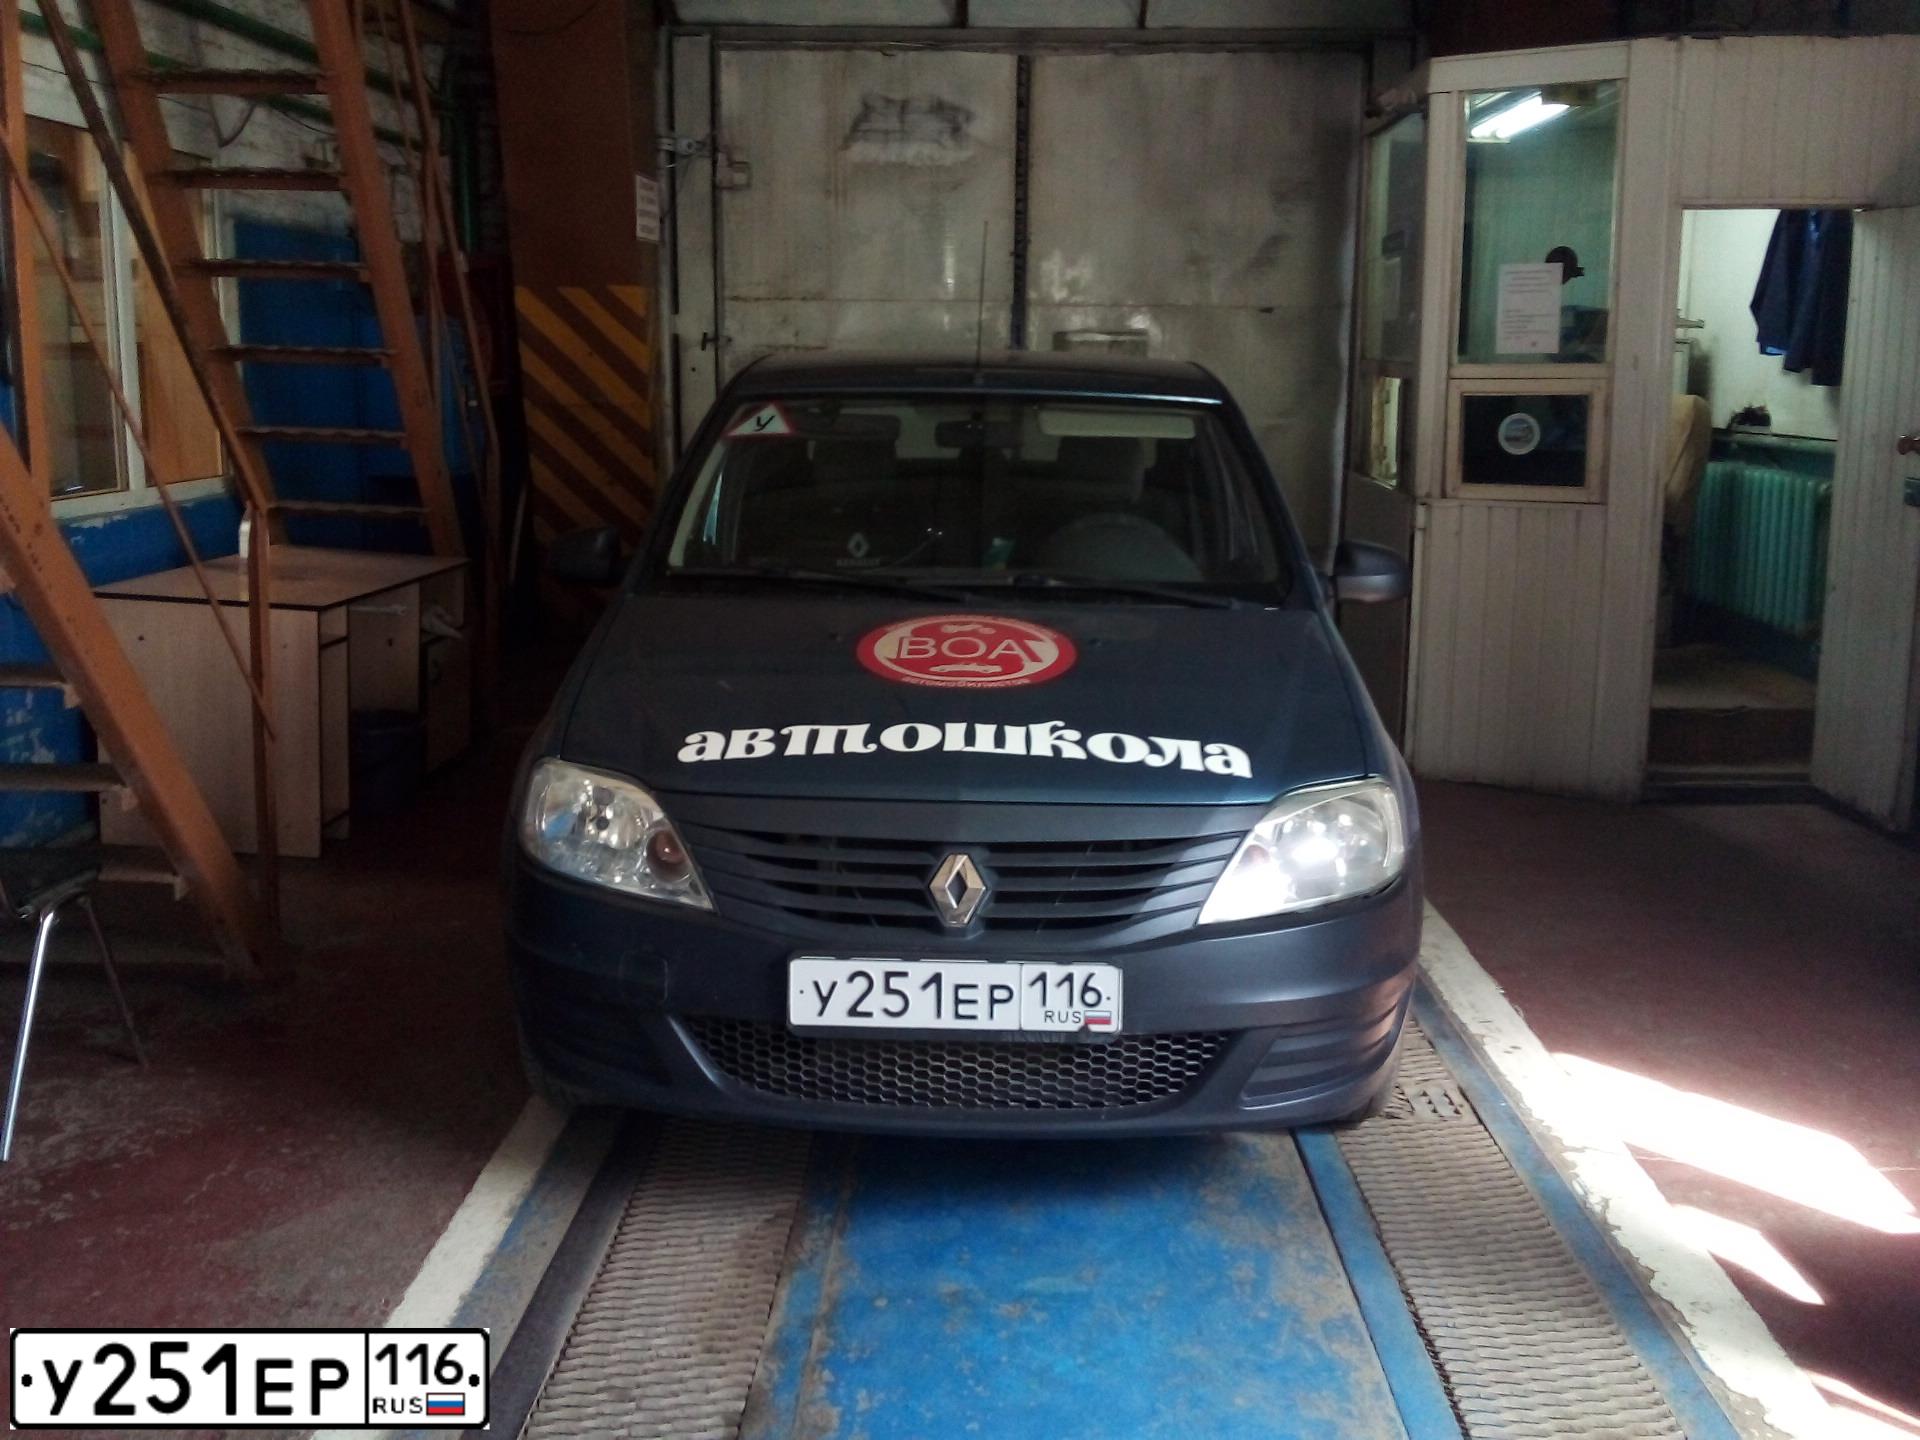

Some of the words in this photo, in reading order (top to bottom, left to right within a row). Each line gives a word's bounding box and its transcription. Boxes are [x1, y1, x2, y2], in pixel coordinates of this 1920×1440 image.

[677, 720, 1253, 778] автошкола
[1028, 971, 1102, 1008] 116
[1044, 1010, 1081, 1024] RUS
